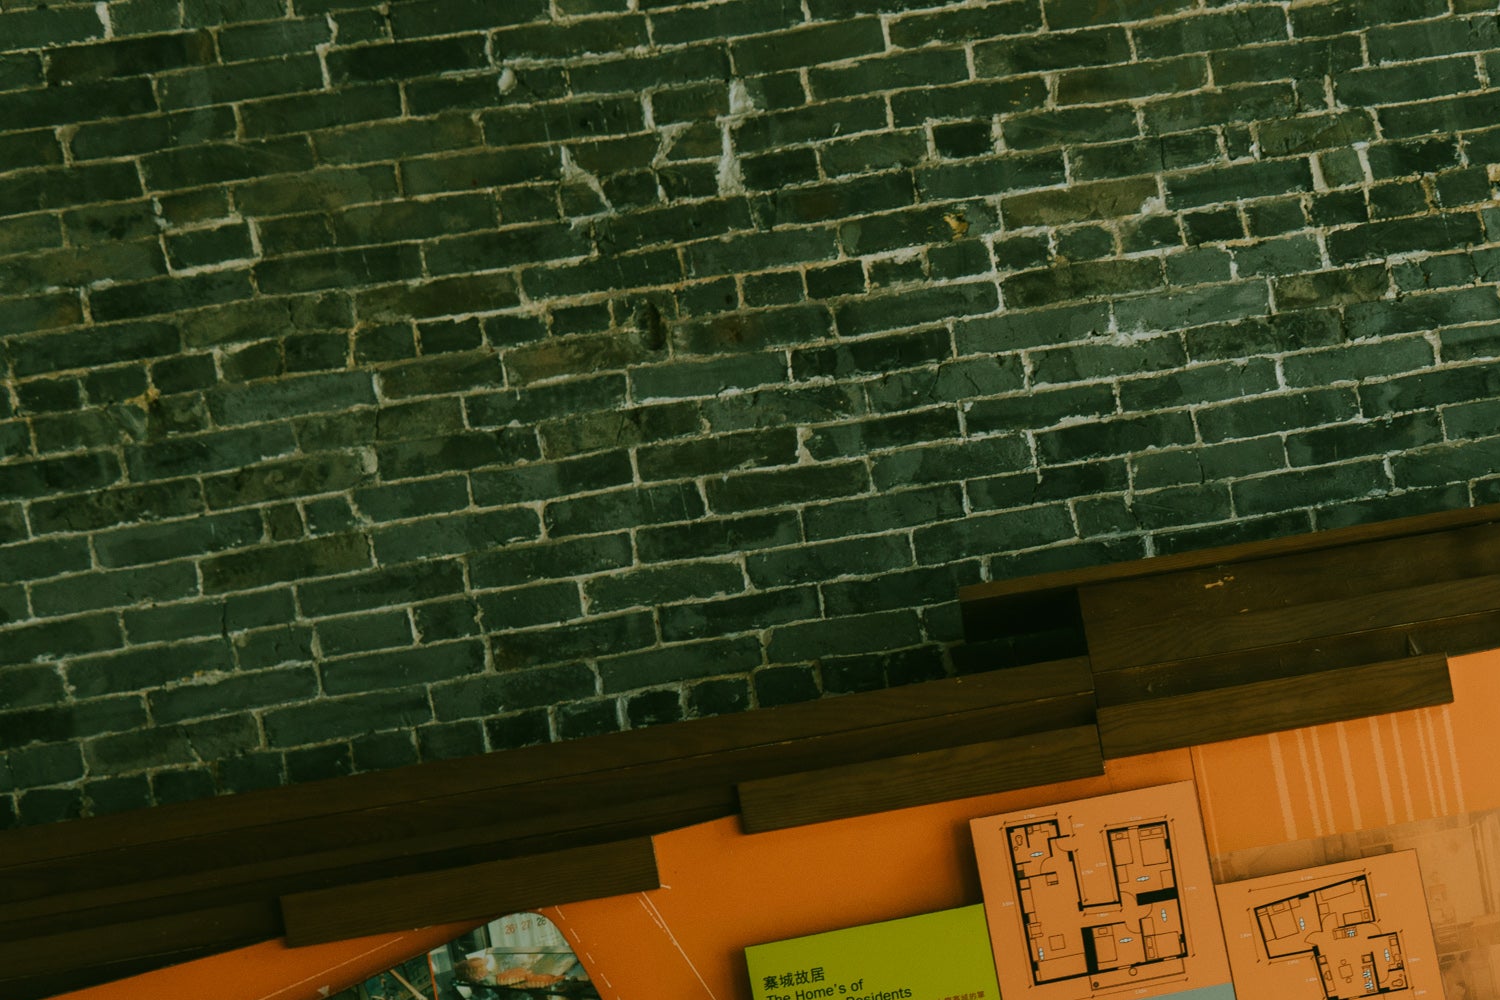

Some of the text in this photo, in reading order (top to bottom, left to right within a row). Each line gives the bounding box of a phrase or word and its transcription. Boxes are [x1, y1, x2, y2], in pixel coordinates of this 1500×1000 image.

[762, 966, 824, 990] 寨城故居
[850, 978, 863, 991] of
